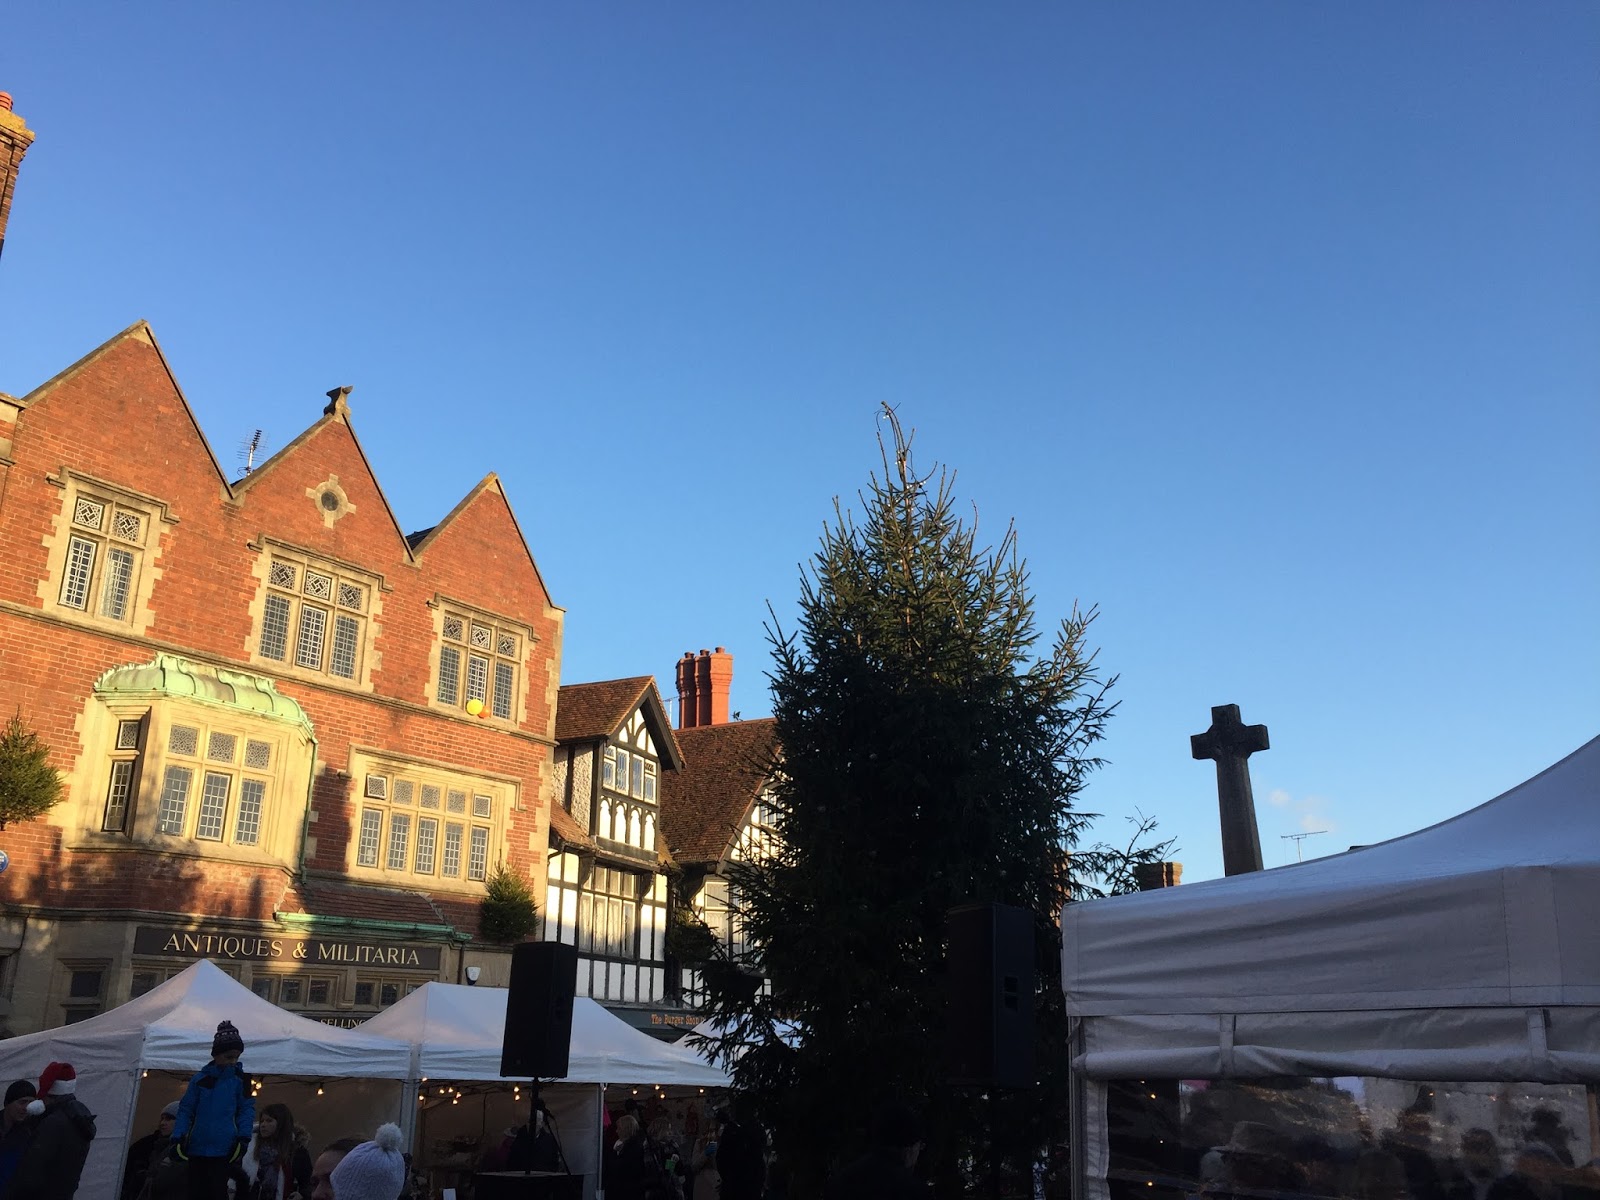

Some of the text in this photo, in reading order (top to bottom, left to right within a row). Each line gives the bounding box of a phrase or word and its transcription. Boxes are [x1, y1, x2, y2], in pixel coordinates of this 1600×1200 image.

[163, 933, 420, 965] ANTIQUES & MILITARIA
[651, 1013, 662, 1024] The
[664, 1014, 684, 1026] Burger
